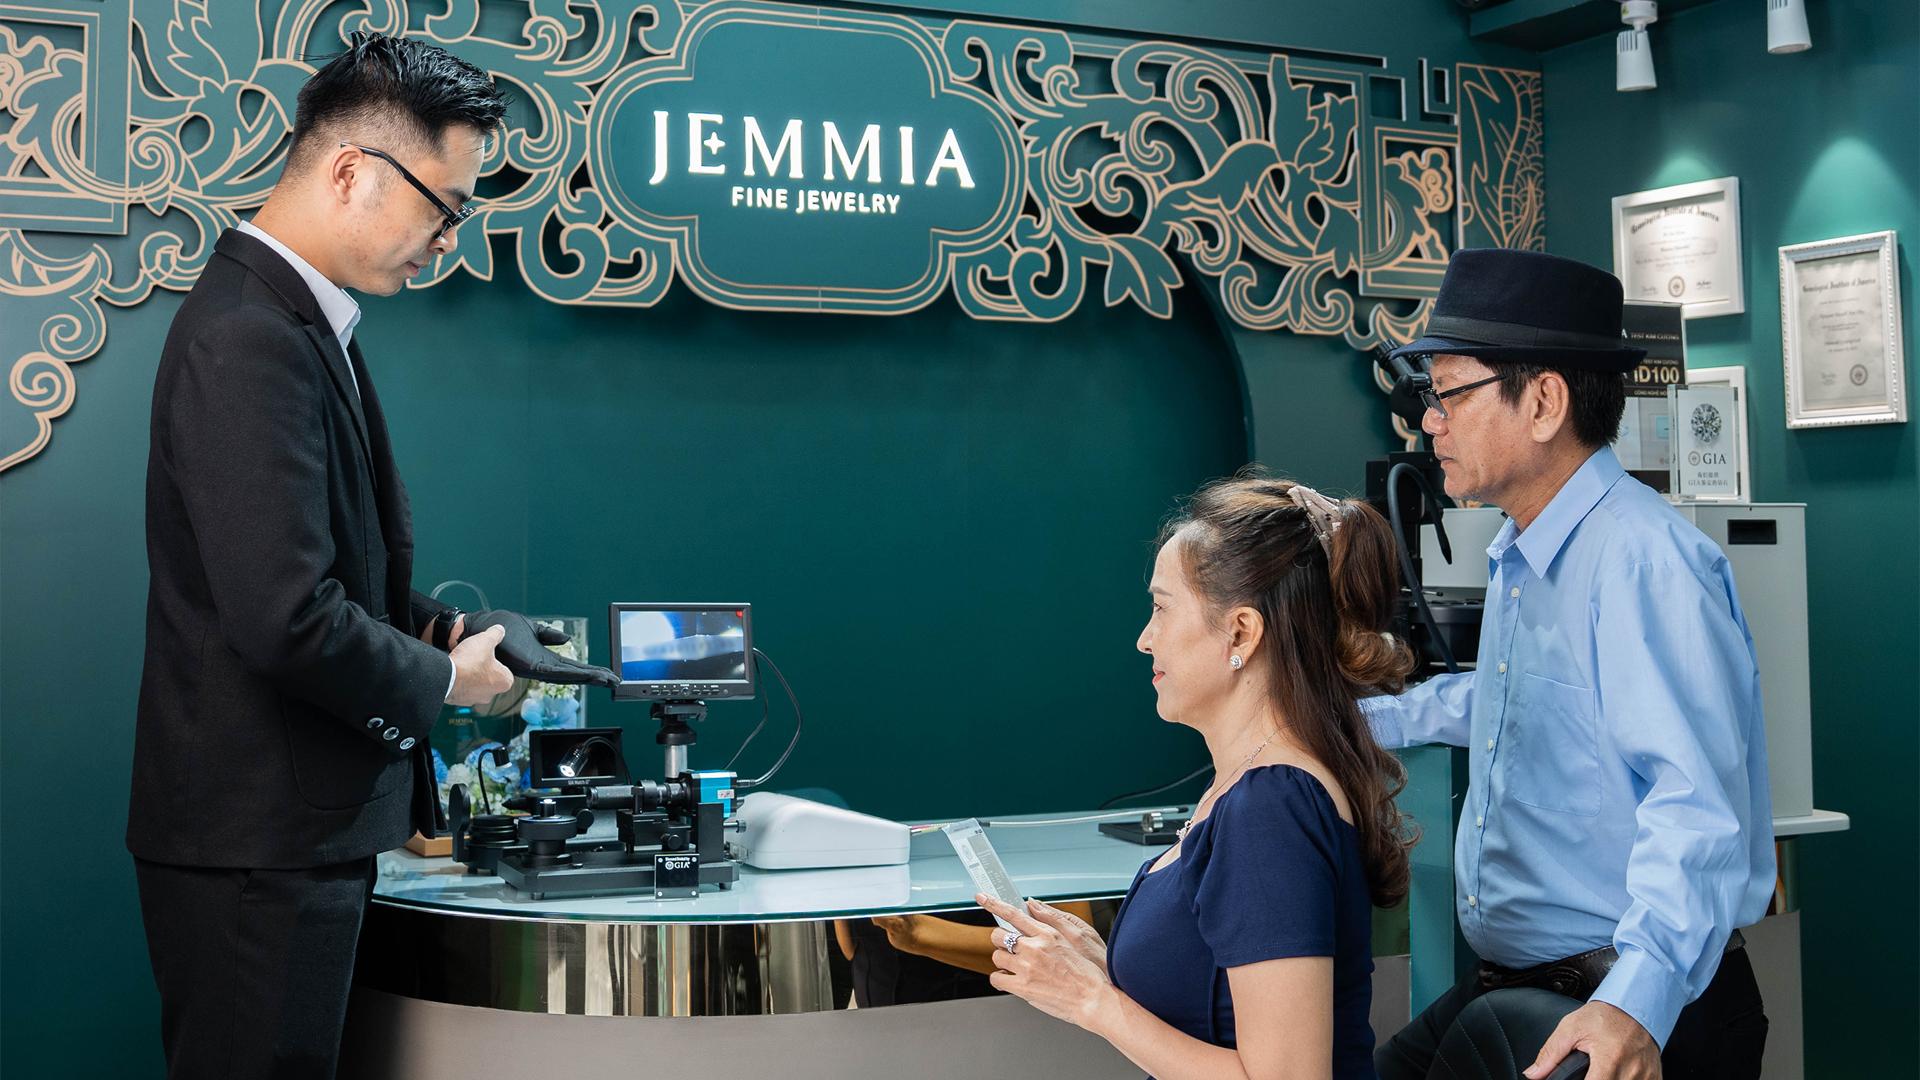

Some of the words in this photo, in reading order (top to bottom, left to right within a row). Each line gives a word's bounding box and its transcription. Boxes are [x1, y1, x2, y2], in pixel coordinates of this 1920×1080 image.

[649, 110, 975, 188] JEMMIA
[732, 186, 788, 209] FINE
[796, 189, 900, 214] JEWELRY
[1702, 452, 1726, 465] GIA
